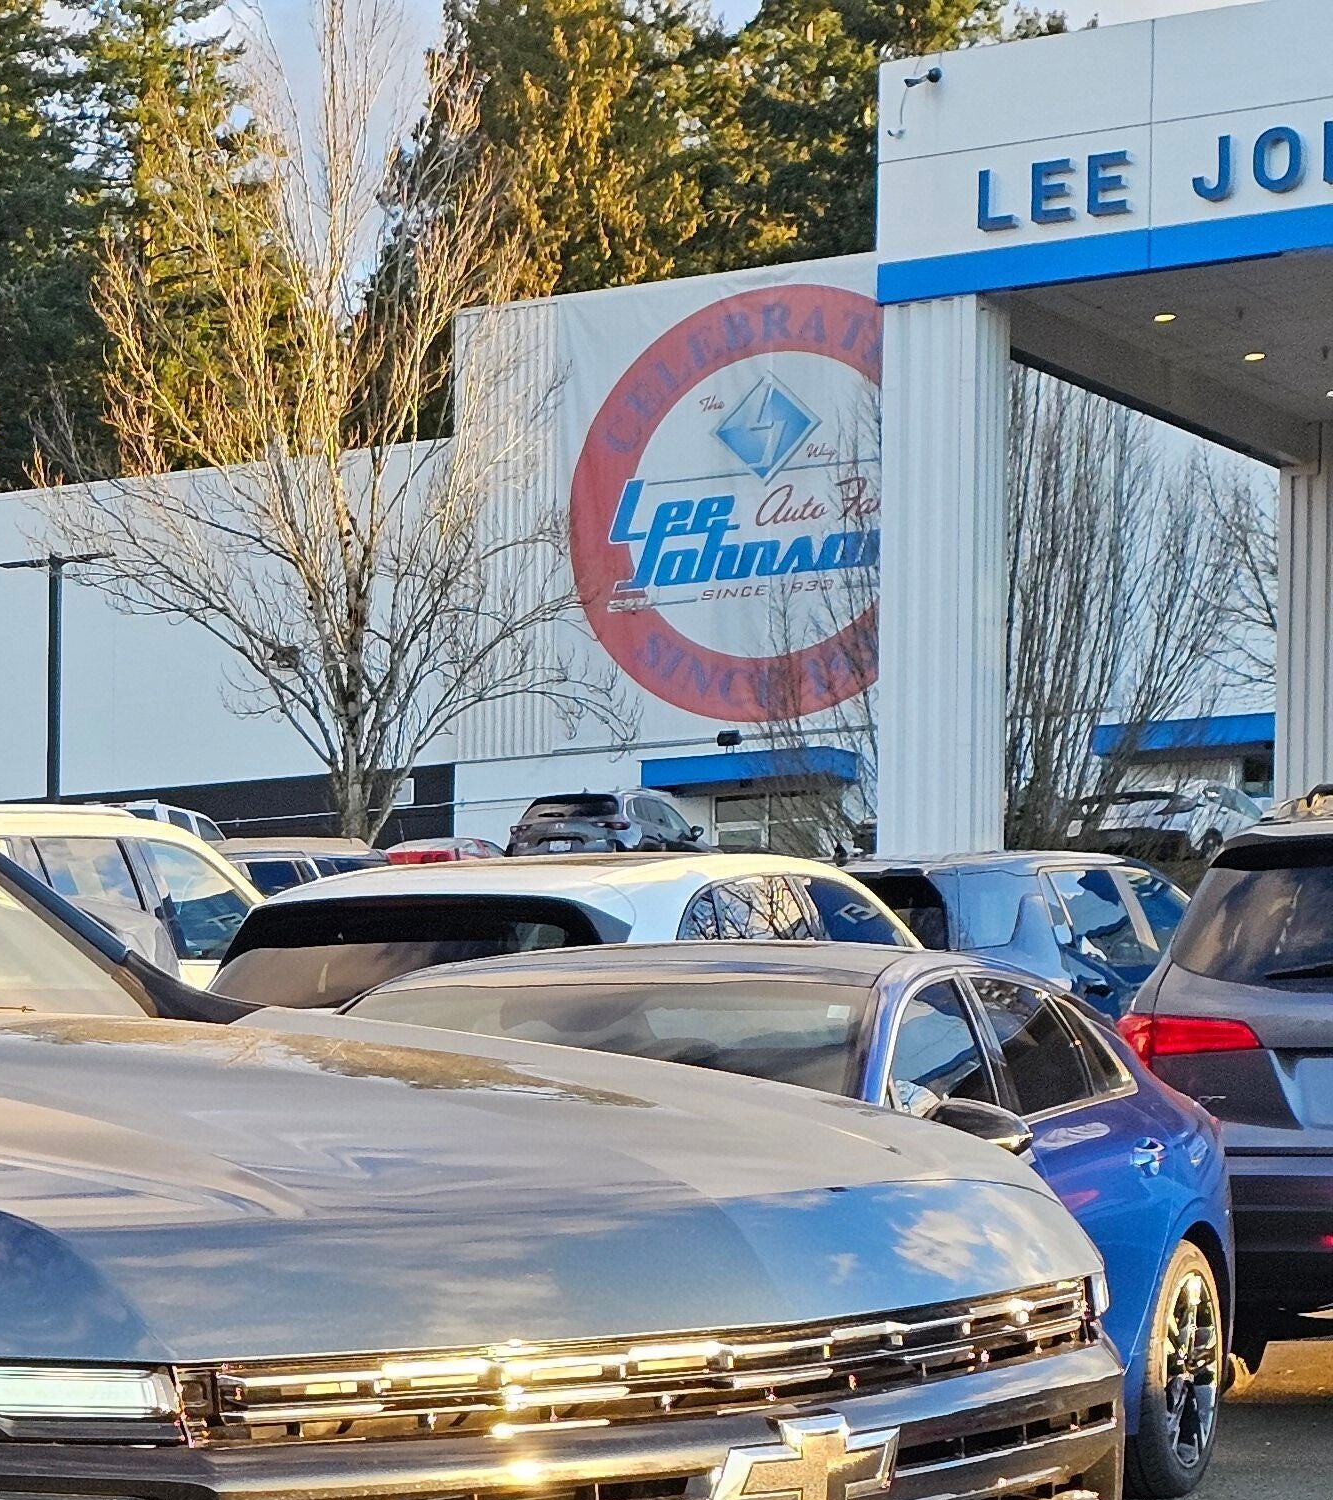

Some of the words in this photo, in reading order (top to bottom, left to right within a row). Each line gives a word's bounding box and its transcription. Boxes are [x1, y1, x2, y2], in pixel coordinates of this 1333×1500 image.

[978, 150, 1133, 232] LEE
[1192, 121, 1333, 202] JO
[699, 395, 725, 416] The
[609, 478, 740, 544] Lee
[755, 484, 828, 527] Auto
[835, 476, 881, 520] Fa
[701, 586, 769, 601] SINCE
